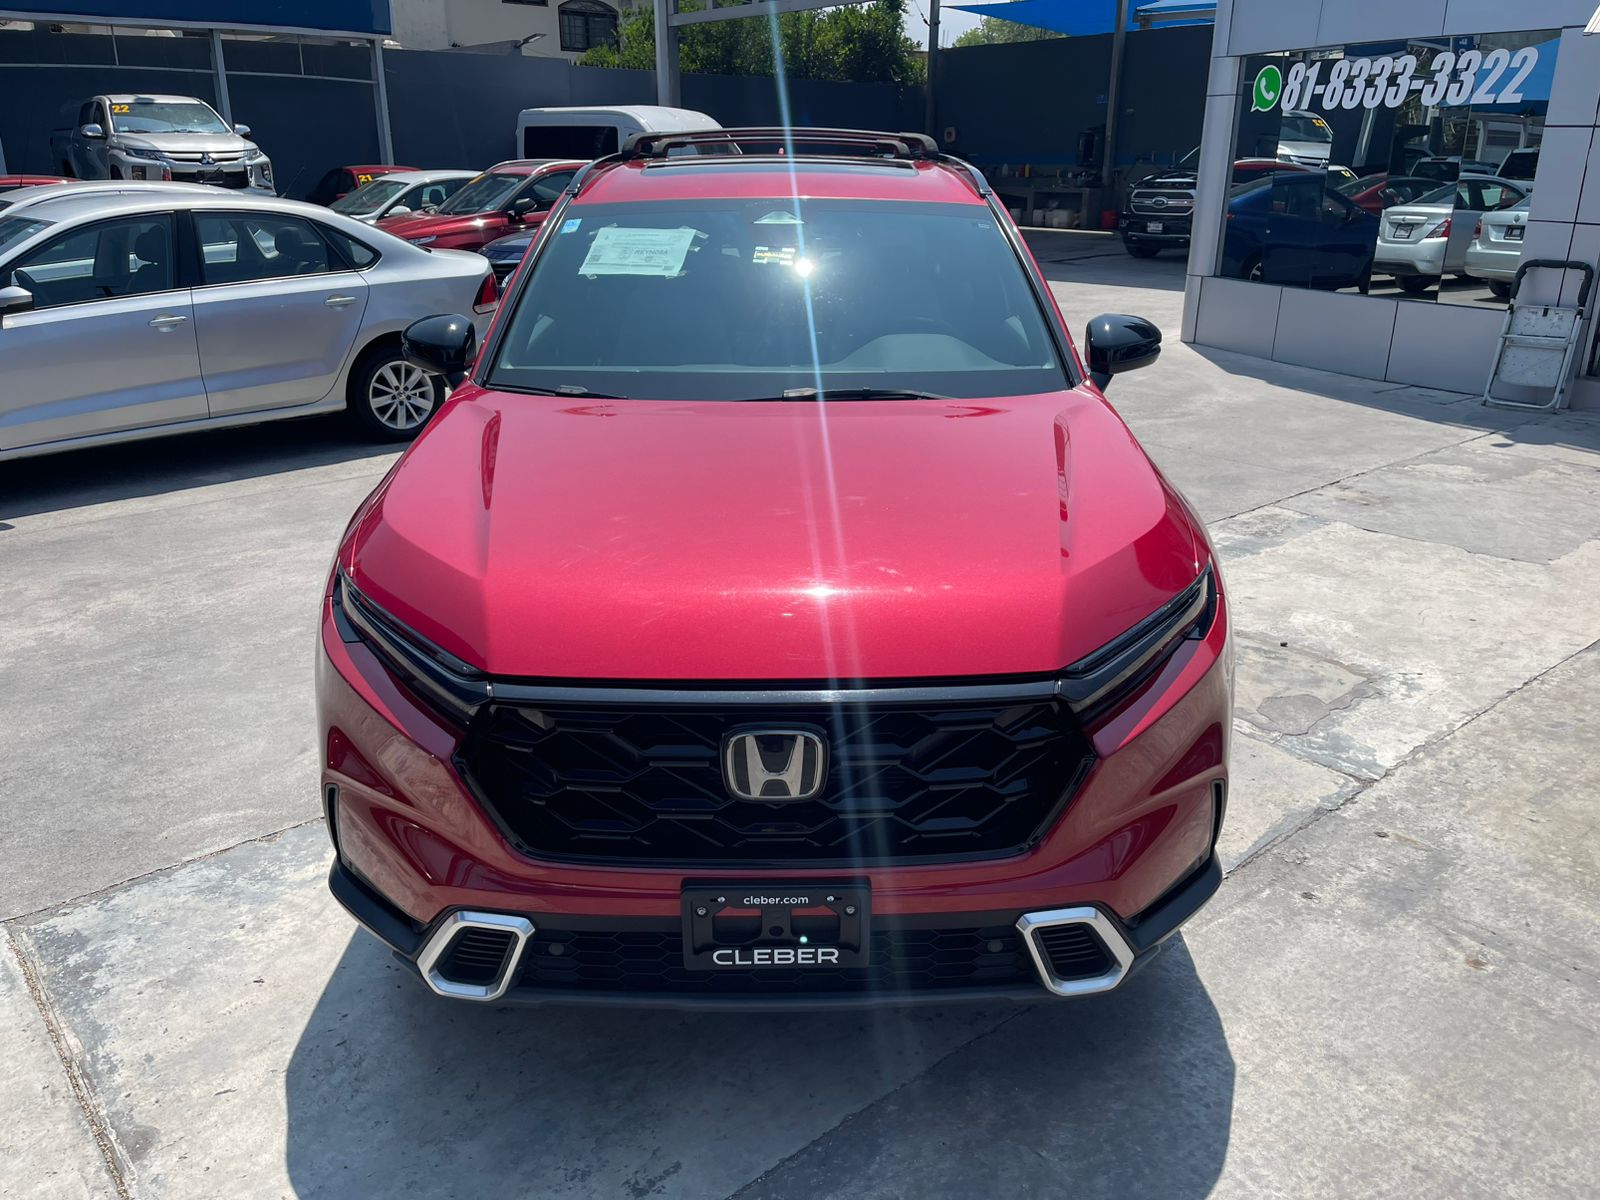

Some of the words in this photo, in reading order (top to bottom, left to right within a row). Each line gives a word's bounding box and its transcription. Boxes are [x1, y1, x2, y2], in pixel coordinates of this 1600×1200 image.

[1280, 46, 1539, 111] 81-8333-3322
[112, 104, 130, 113] 22
[743, 895, 809, 905] cleber.com
[712, 948, 839, 965] CLEBER
